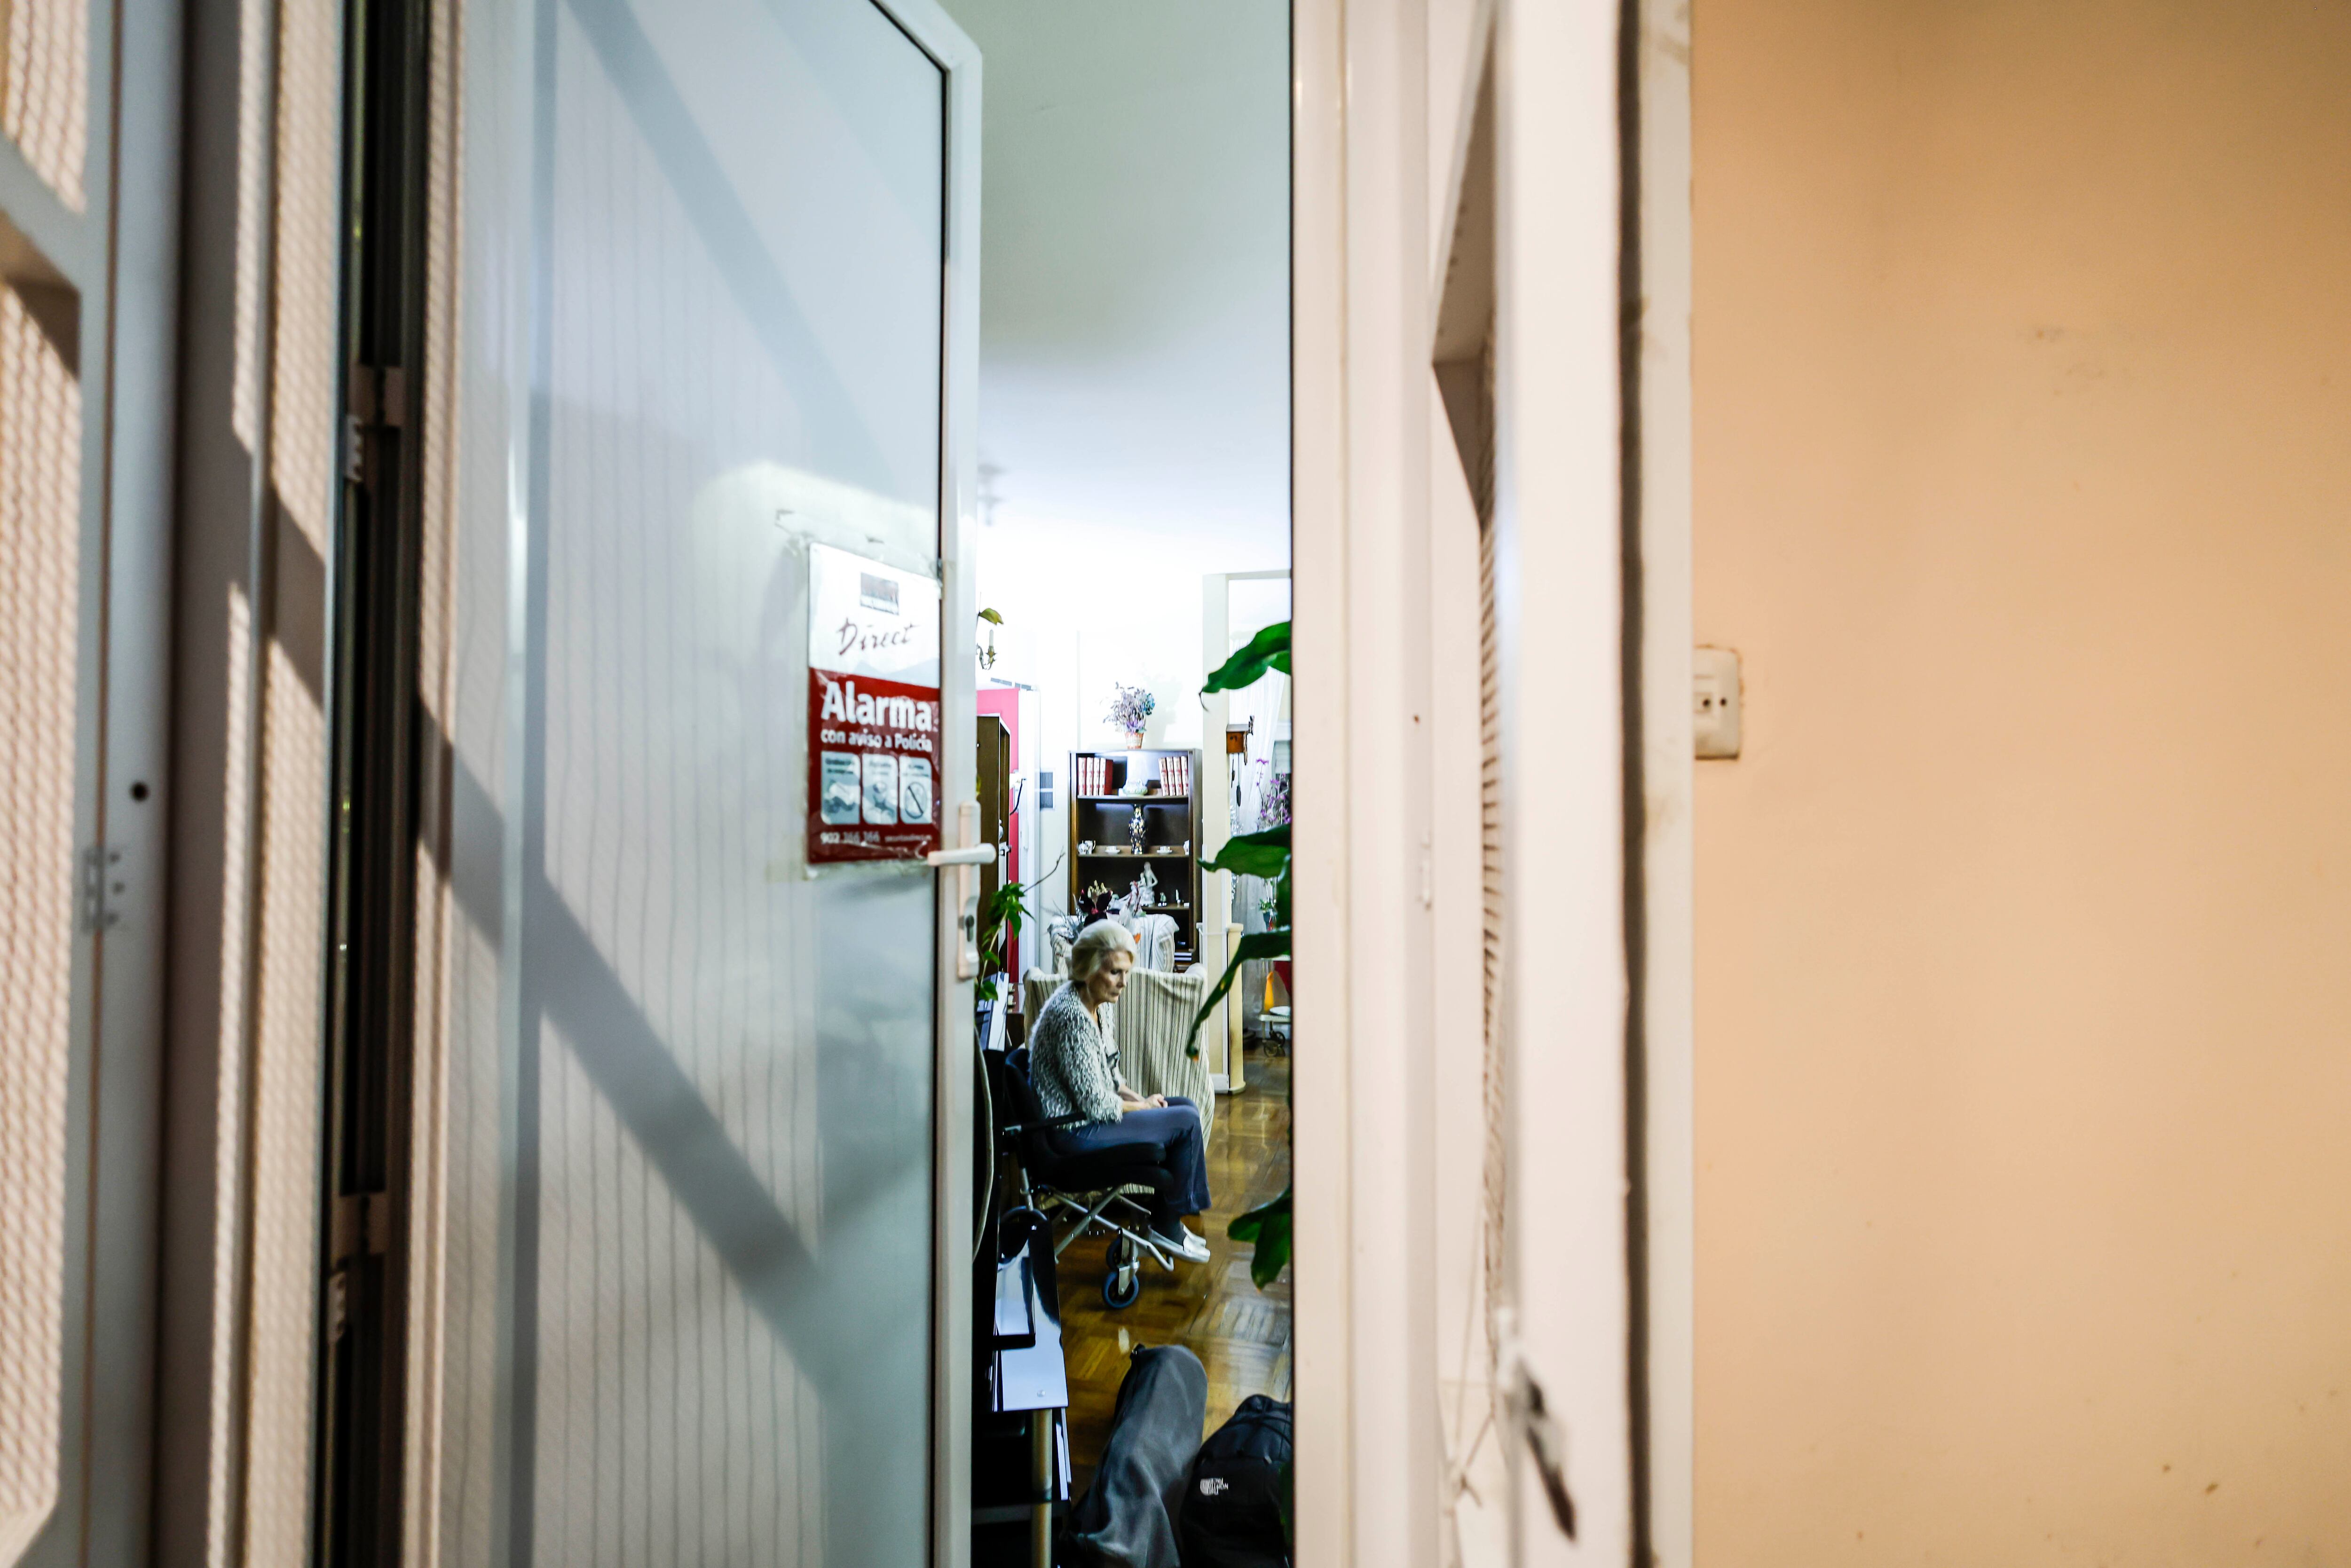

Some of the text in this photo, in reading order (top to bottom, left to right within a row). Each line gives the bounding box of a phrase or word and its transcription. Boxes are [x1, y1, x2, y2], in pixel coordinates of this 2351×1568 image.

[836, 618, 920, 655] Direct
[821, 681, 932, 732] Alarma
[820, 729, 845, 743] con
[848, 728, 882, 748] aviso
[884, 734, 892, 748] a
